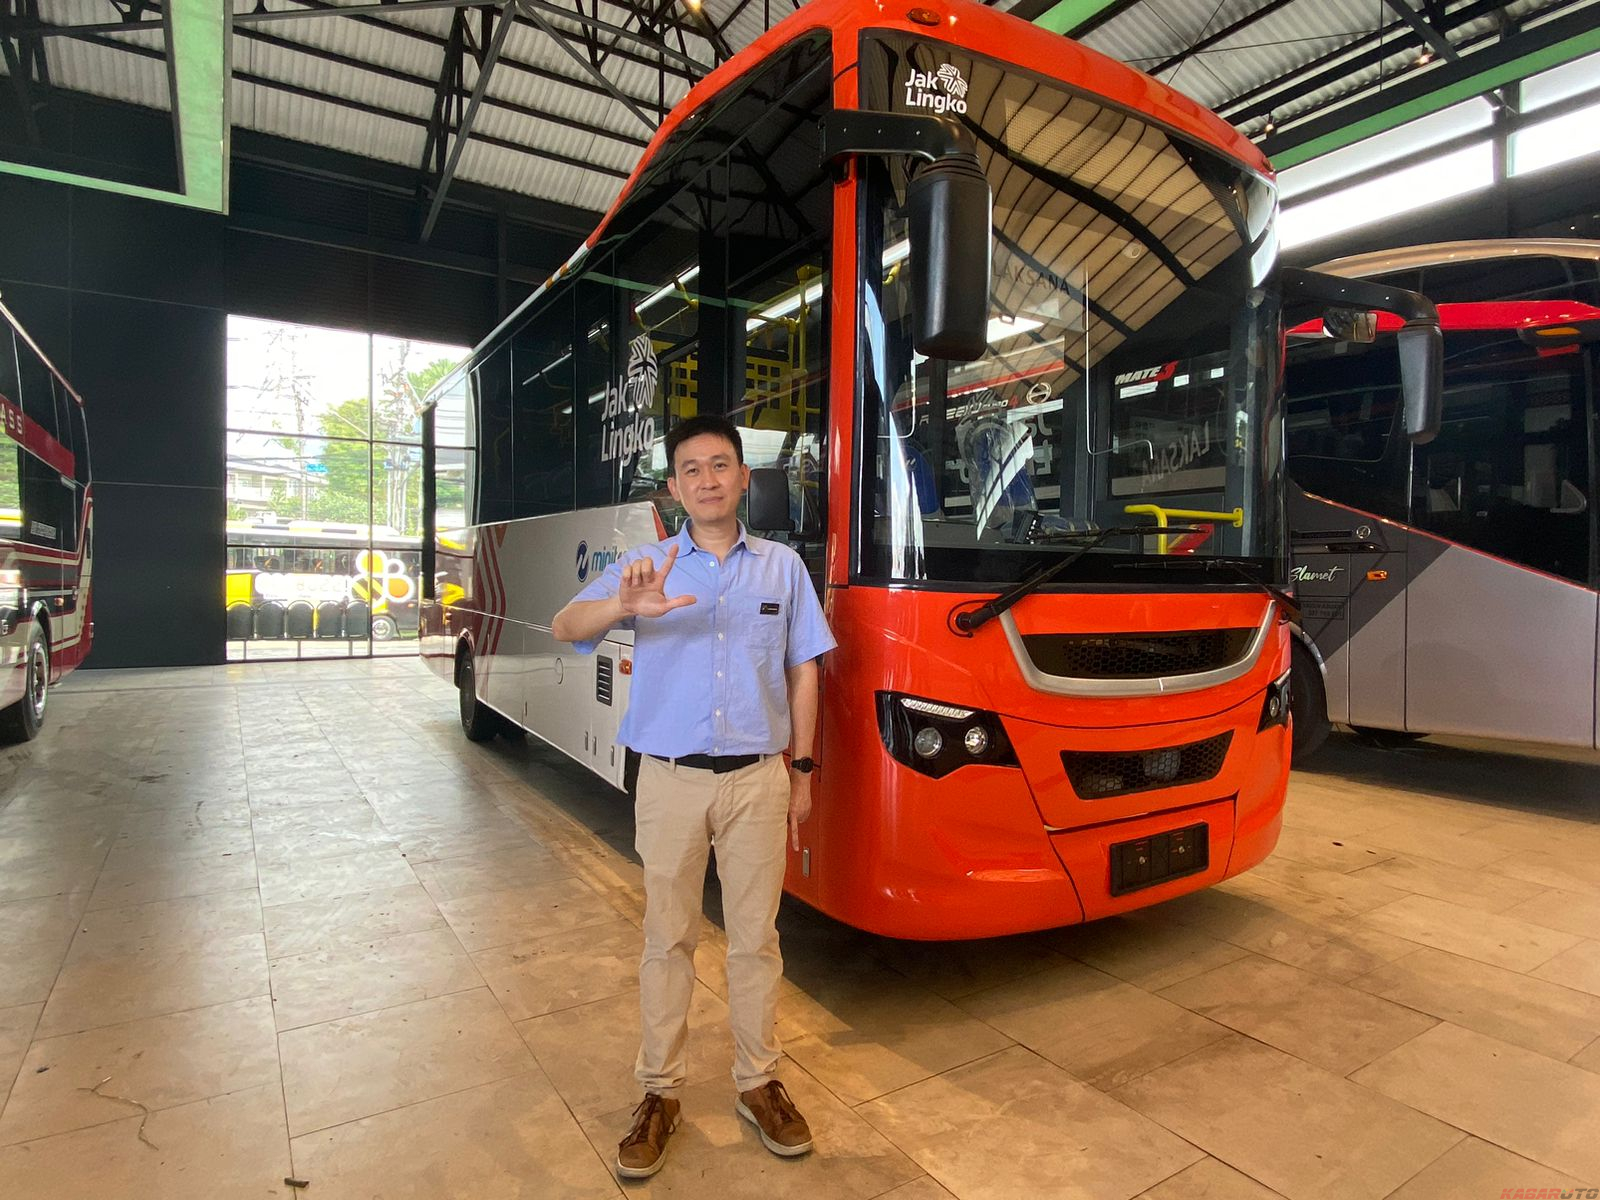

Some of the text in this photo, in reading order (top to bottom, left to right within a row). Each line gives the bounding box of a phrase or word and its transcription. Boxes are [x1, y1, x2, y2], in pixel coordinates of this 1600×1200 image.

[905, 68, 939, 90] Jak
[905, 87, 967, 114] Lingko
[992, 262, 1071, 297] LAKSANA
[601, 374, 629, 422] Jak
[601, 412, 655, 467] Lingko
[1290, 565, 1345, 582] Slamet
